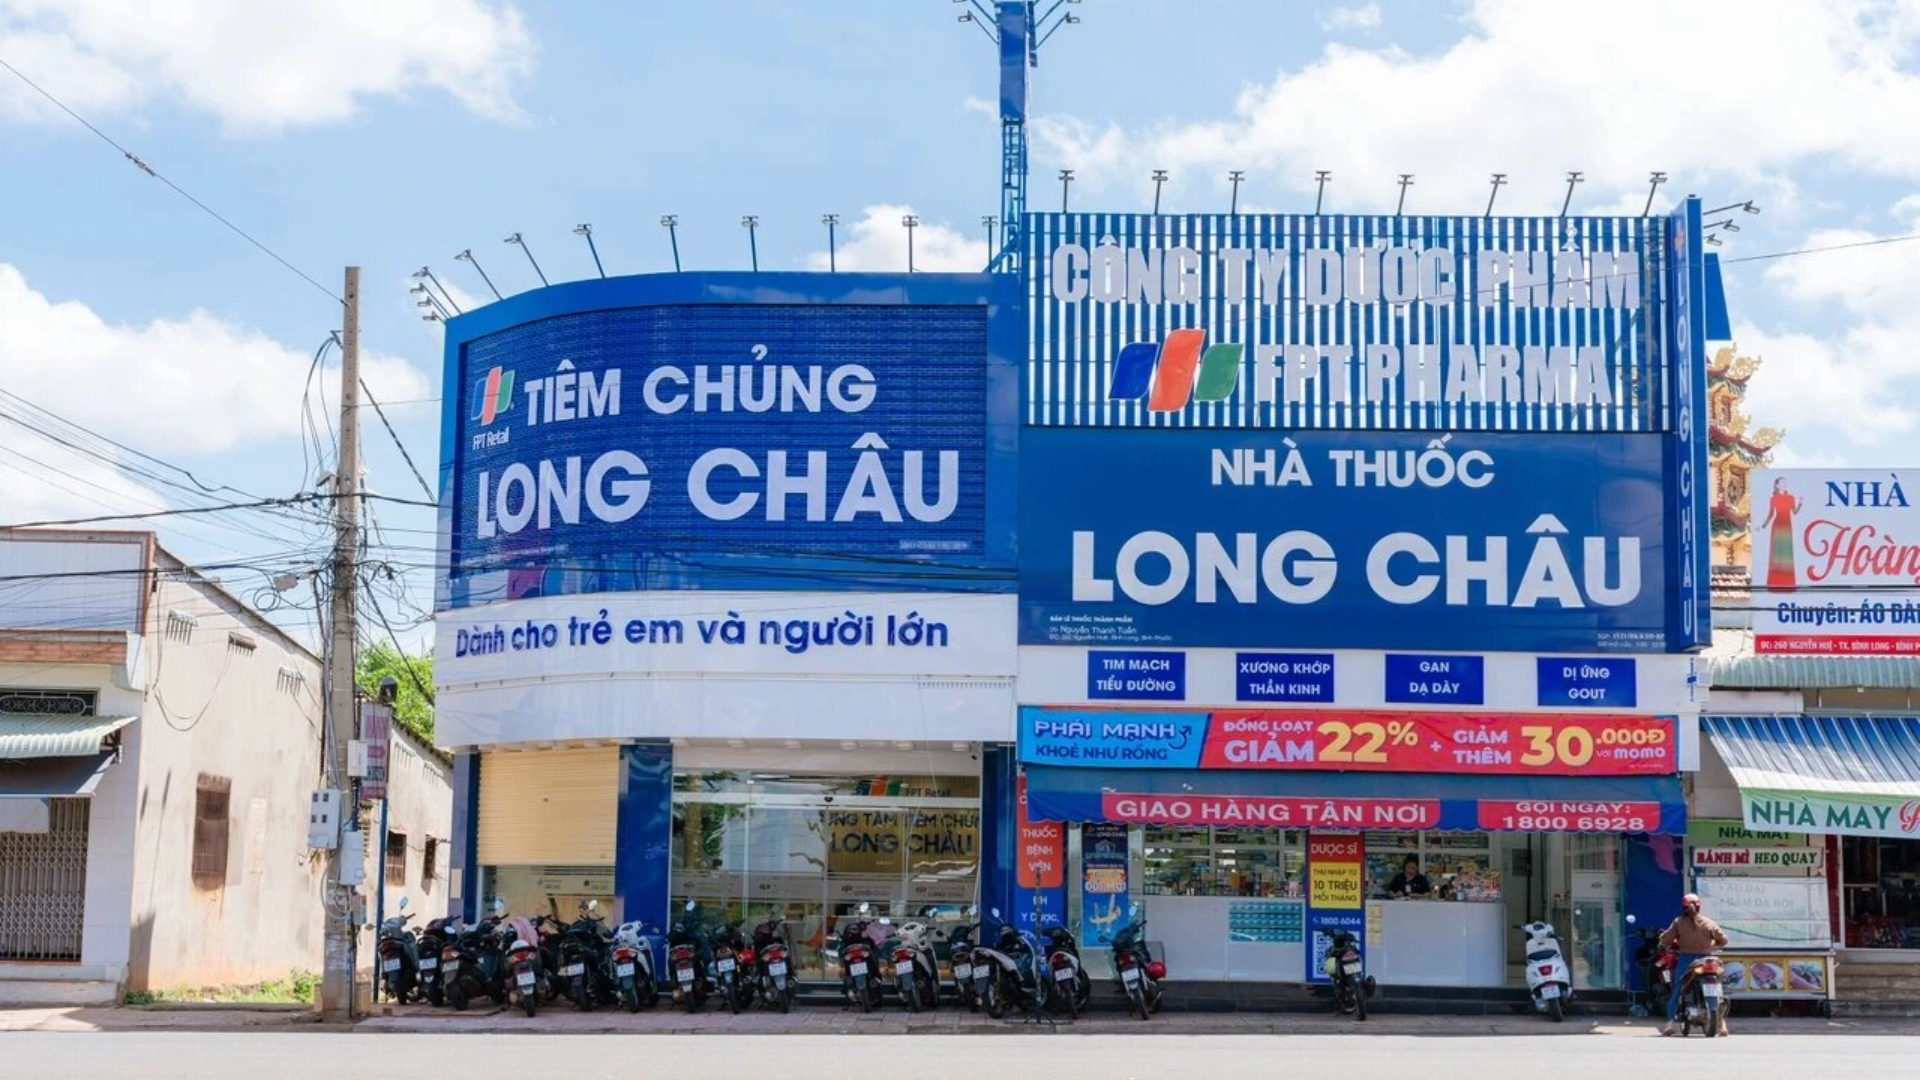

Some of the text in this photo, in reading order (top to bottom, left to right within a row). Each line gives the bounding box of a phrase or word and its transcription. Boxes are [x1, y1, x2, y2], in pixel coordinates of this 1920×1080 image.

[1052, 226, 1640, 316] CÔNG TY DƯỢC PHẨM
[1676, 270, 1691, 444] LONG
[1258, 343, 1612, 404] FPT PHARMA
[524, 344, 877, 426] TIÊM CHỦNG
[472, 426, 510, 450] FPT Retail
[1211, 433, 1495, 488] NHÀ THUỐC
[477, 432, 960, 540] LONG CHÂU
[1825, 473, 1911, 507] NHÀ
[1679, 461, 1693, 635] CHÂU
[1803, 519, 1920, 585] Hoàn
[1072, 513, 1641, 608] LONG CHÂU
[1777, 602, 1855, 626] Chuyên:
[1860, 598, 1885, 624] ÁO
[454, 608, 948, 658] Dành cho trẻ em và người lớn
[1871, 642, 1889, 650] LONG
[1103, 659, 1171, 674] TIM MẠCH
[1240, 661, 1331, 675] XƯƠNG KHỚP
[1419, 661, 1450, 673] GAN
[1562, 665, 1610, 681] DỊ ỨNG
[1096, 675, 1176, 692] TIỂU ĐƯỜNG
[1289, 684, 1321, 695] KINH
[1409, 681, 1460, 696] DẠ DÀY
[1568, 688, 1606, 700] GOUT
[1034, 719, 1176, 742] PHÁI MẠNH
[1273, 720, 1314, 734] LOẠT
[1453, 725, 1508, 744] GIẢM
[1223, 720, 1419, 764] GIẢM 22%
[1083, 745, 1120, 759] NHƯ
[1453, 747, 1512, 765] THÊM
[1115, 799, 1426, 826] GIAO HÀNG TẬN NƠI
[1515, 802, 1630, 814] GỌI NGAY:
[1751, 797, 1816, 826] NHÀ
[1826, 804, 1892, 829] MAY
[1022, 825, 1058, 838] THUỐC
[1502, 816, 1645, 831] 1800 6928
[832, 829, 973, 855] LONG CHÂU
[1026, 844, 1054, 857] BỆNH
[1310, 843, 1345, 857] DƯỢC
[1697, 848, 1733, 864] BÁNH
[1754, 852, 1779, 864] HEO
[1781, 852, 1817, 866] QUAY
[1313, 878, 1358, 893] 10 TRIỆU
[1320, 917, 1361, 925] 1800 6044
